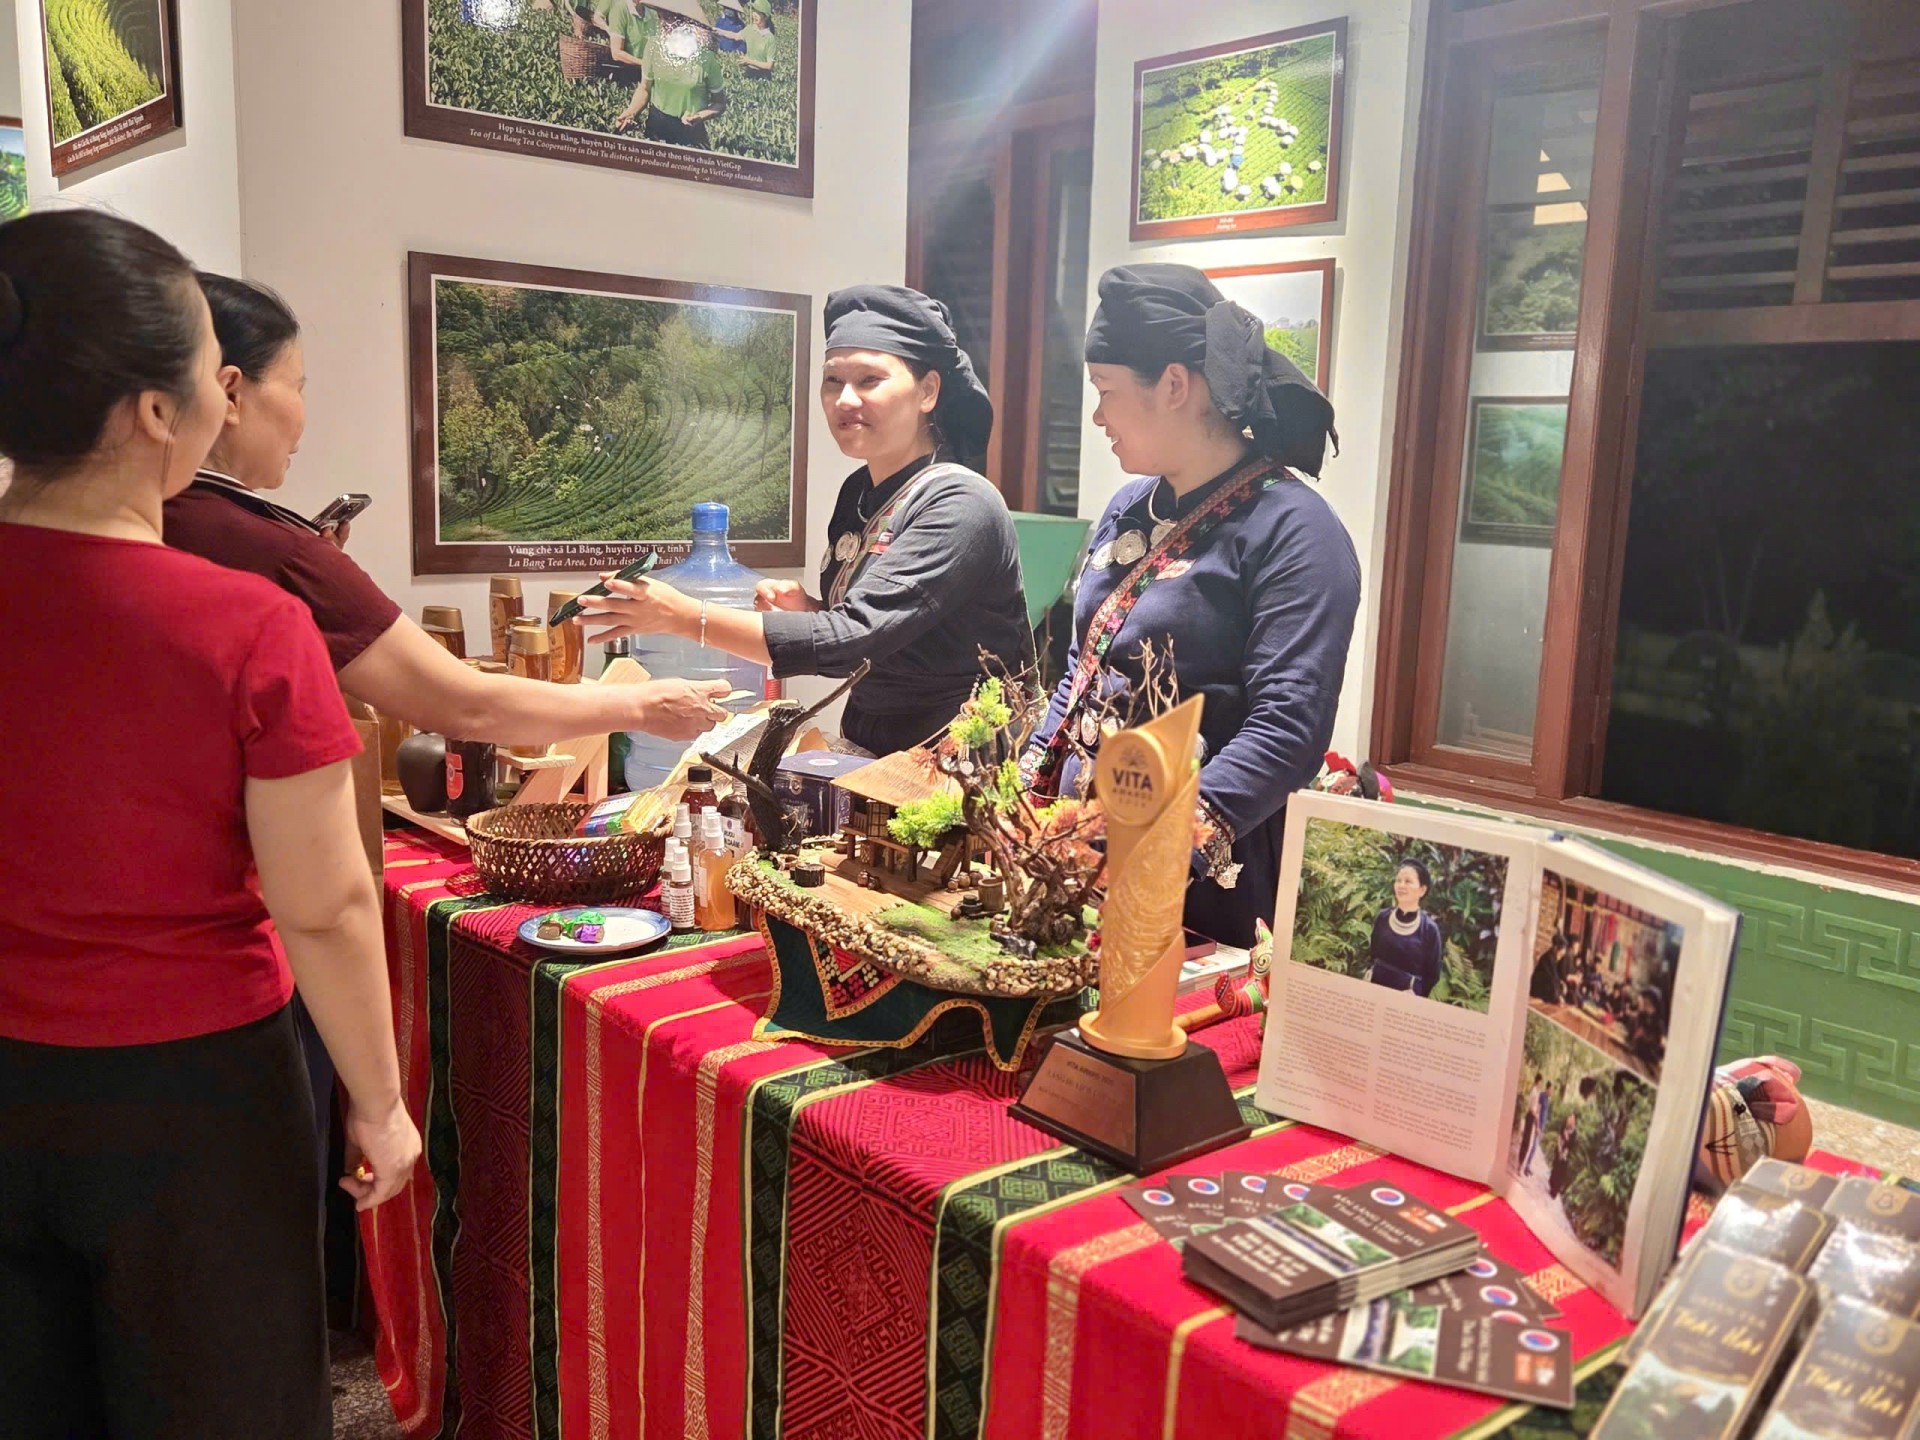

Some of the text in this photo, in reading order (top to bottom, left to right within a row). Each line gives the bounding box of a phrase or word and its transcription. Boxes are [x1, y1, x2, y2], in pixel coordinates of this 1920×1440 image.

[469, 128, 763, 183] Tea of La Bang Tea Cooperative in Dai Tu district is produced according to VietGap standards
[550, 131, 559, 140] La
[716, 159, 742, 172] VietGap
[508, 545, 534, 556] Vùng
[536, 545, 552, 555] chè
[554, 545, 564, 554] xã
[566, 545, 577, 554] La
[605, 544, 632, 556] huyện
[634, 544, 649, 555] Đại
[508, 558, 520, 567] La
[523, 557, 545, 570] Bang
[547, 557, 563, 567] Tea
[564, 557, 587, 568] Area,
[589, 557, 605, 567] Dai
[606, 557, 618, 566] Tu
[1112, 767, 1153, 792] VITA
